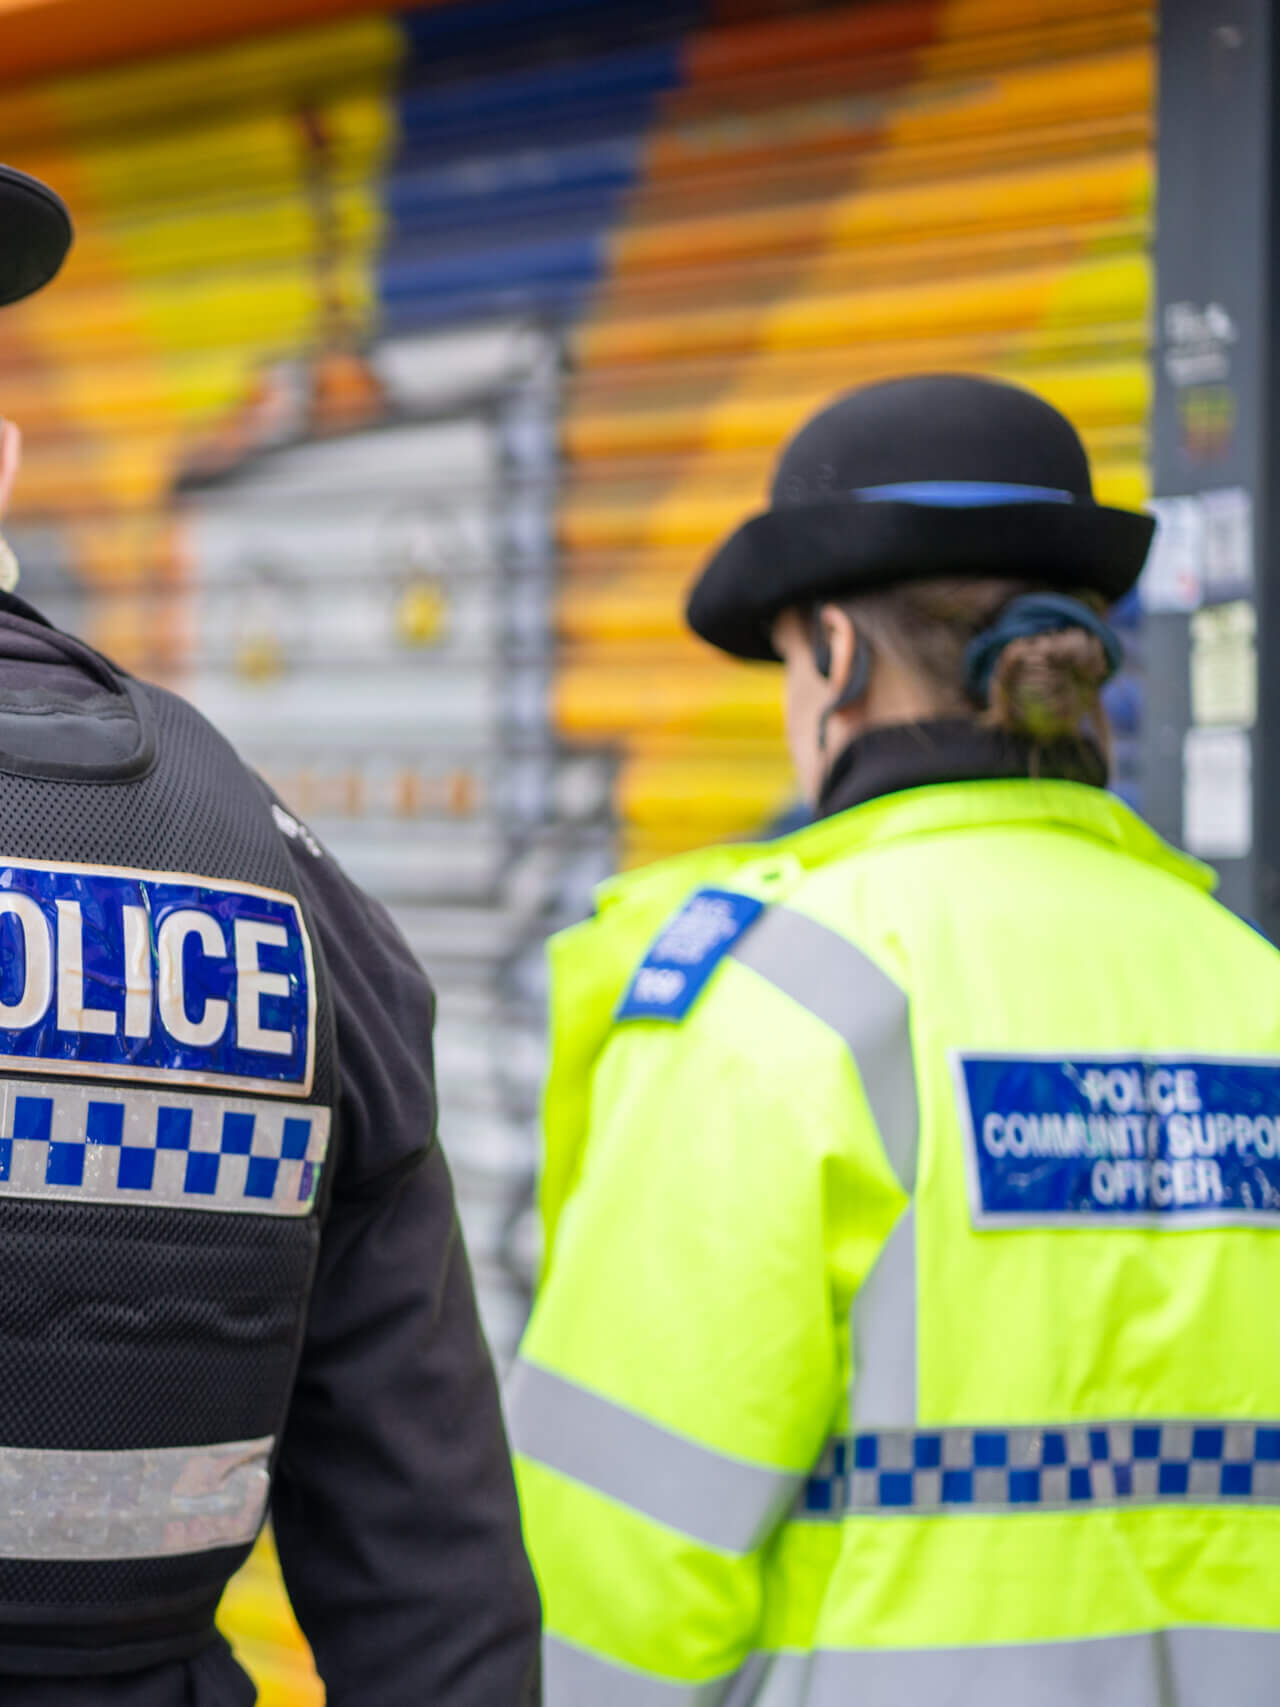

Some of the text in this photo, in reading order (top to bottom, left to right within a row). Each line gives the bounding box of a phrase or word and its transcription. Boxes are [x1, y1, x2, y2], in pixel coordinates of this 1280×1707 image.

[1085, 1068, 1202, 1114] POLCE
[1167, 1113, 1280, 1159] SUPPO
[1092, 1159, 1223, 1206] OFFCER
